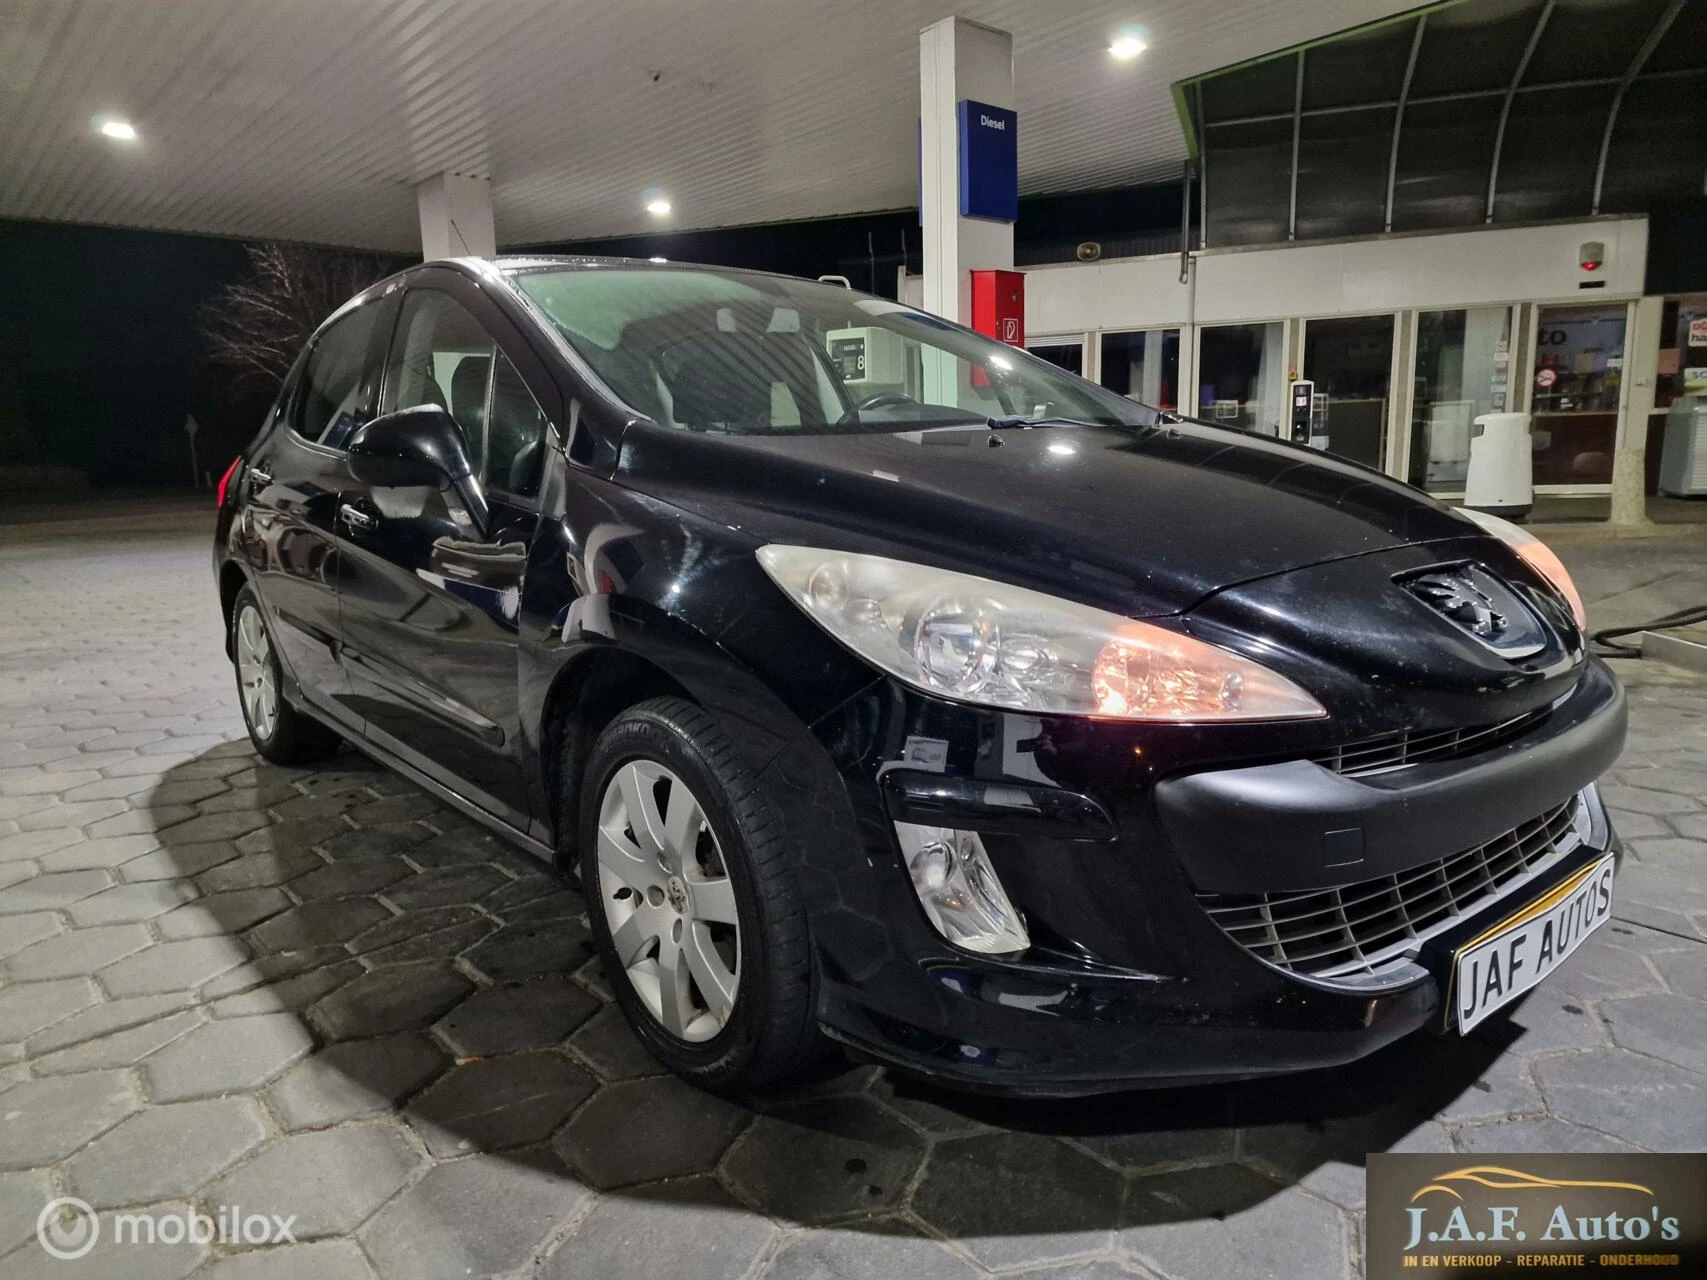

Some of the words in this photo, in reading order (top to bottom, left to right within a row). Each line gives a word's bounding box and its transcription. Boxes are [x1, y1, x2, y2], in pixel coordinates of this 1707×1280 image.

[980, 114, 1005, 131] Diesel
[857, 355, 865, 370] 8
[1463, 933, 1527, 1020] JAF
[1535, 868, 1611, 975] AUTOS
